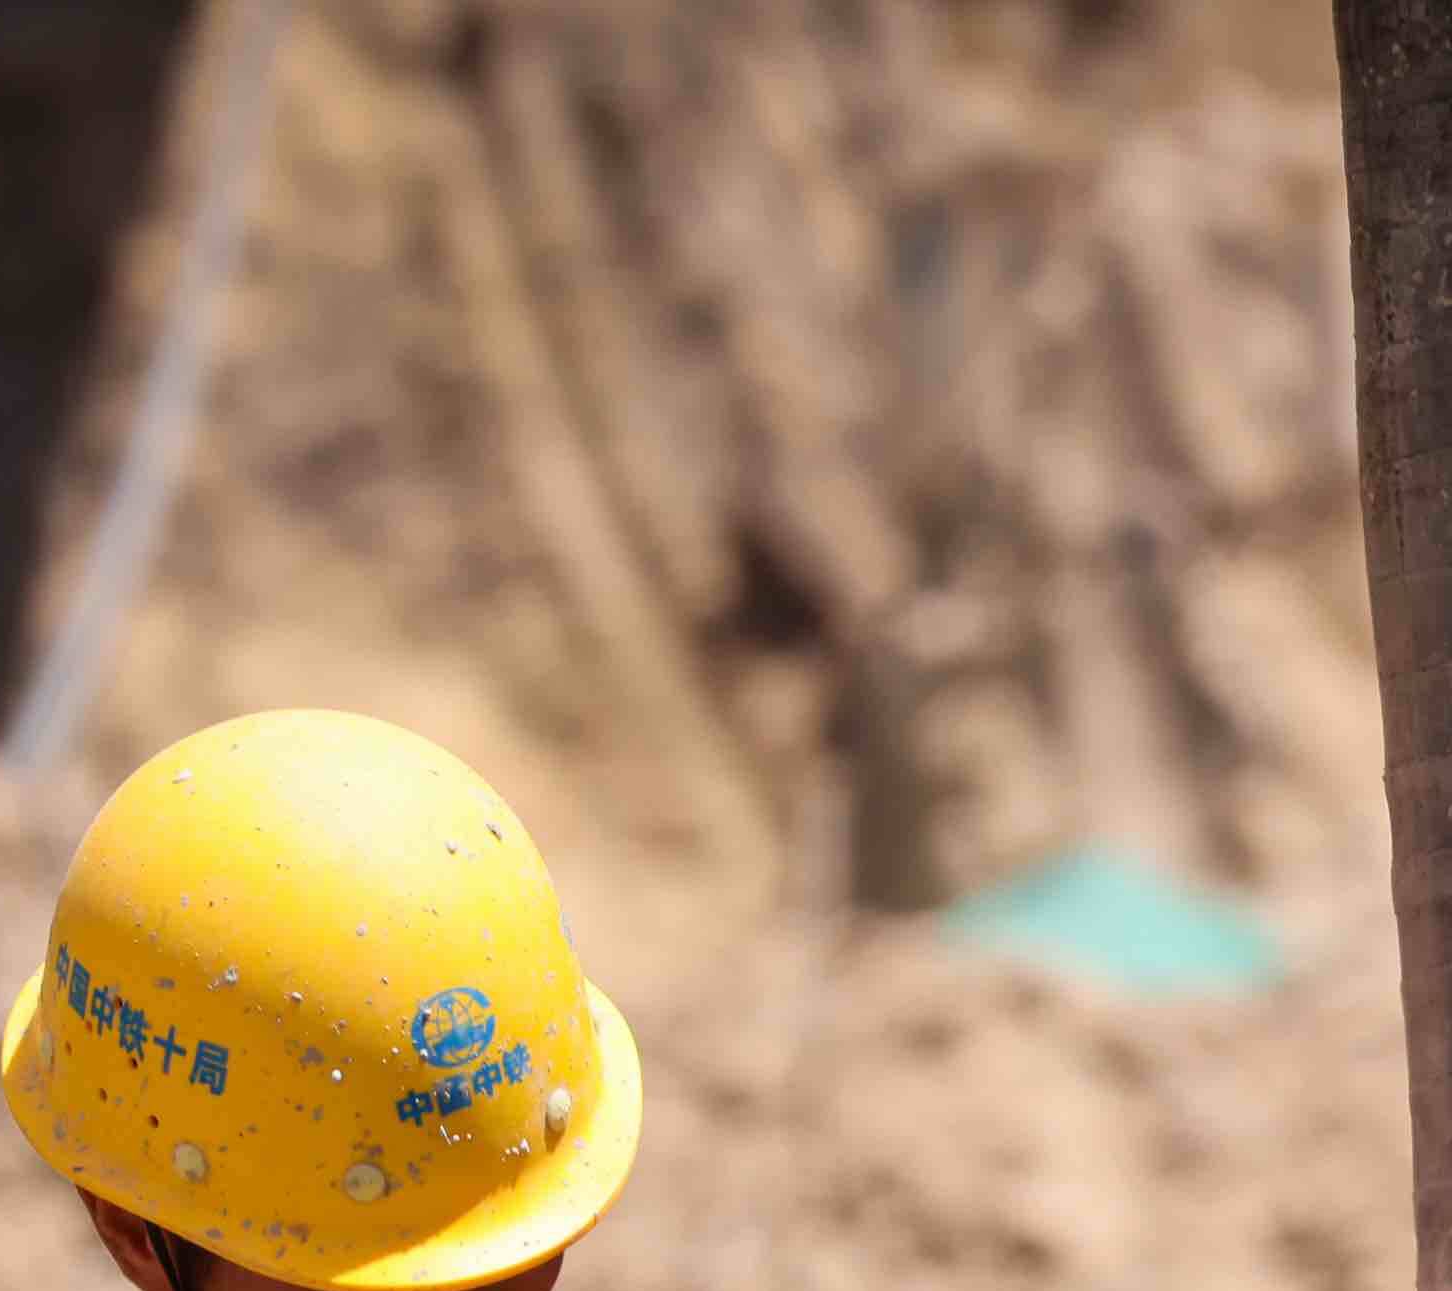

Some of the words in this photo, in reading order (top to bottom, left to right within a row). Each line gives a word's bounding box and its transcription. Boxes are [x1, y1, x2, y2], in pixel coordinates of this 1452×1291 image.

[55, 941, 231, 1097] 中国中铁十局
[395, 1042, 533, 1128] 中国中铁
